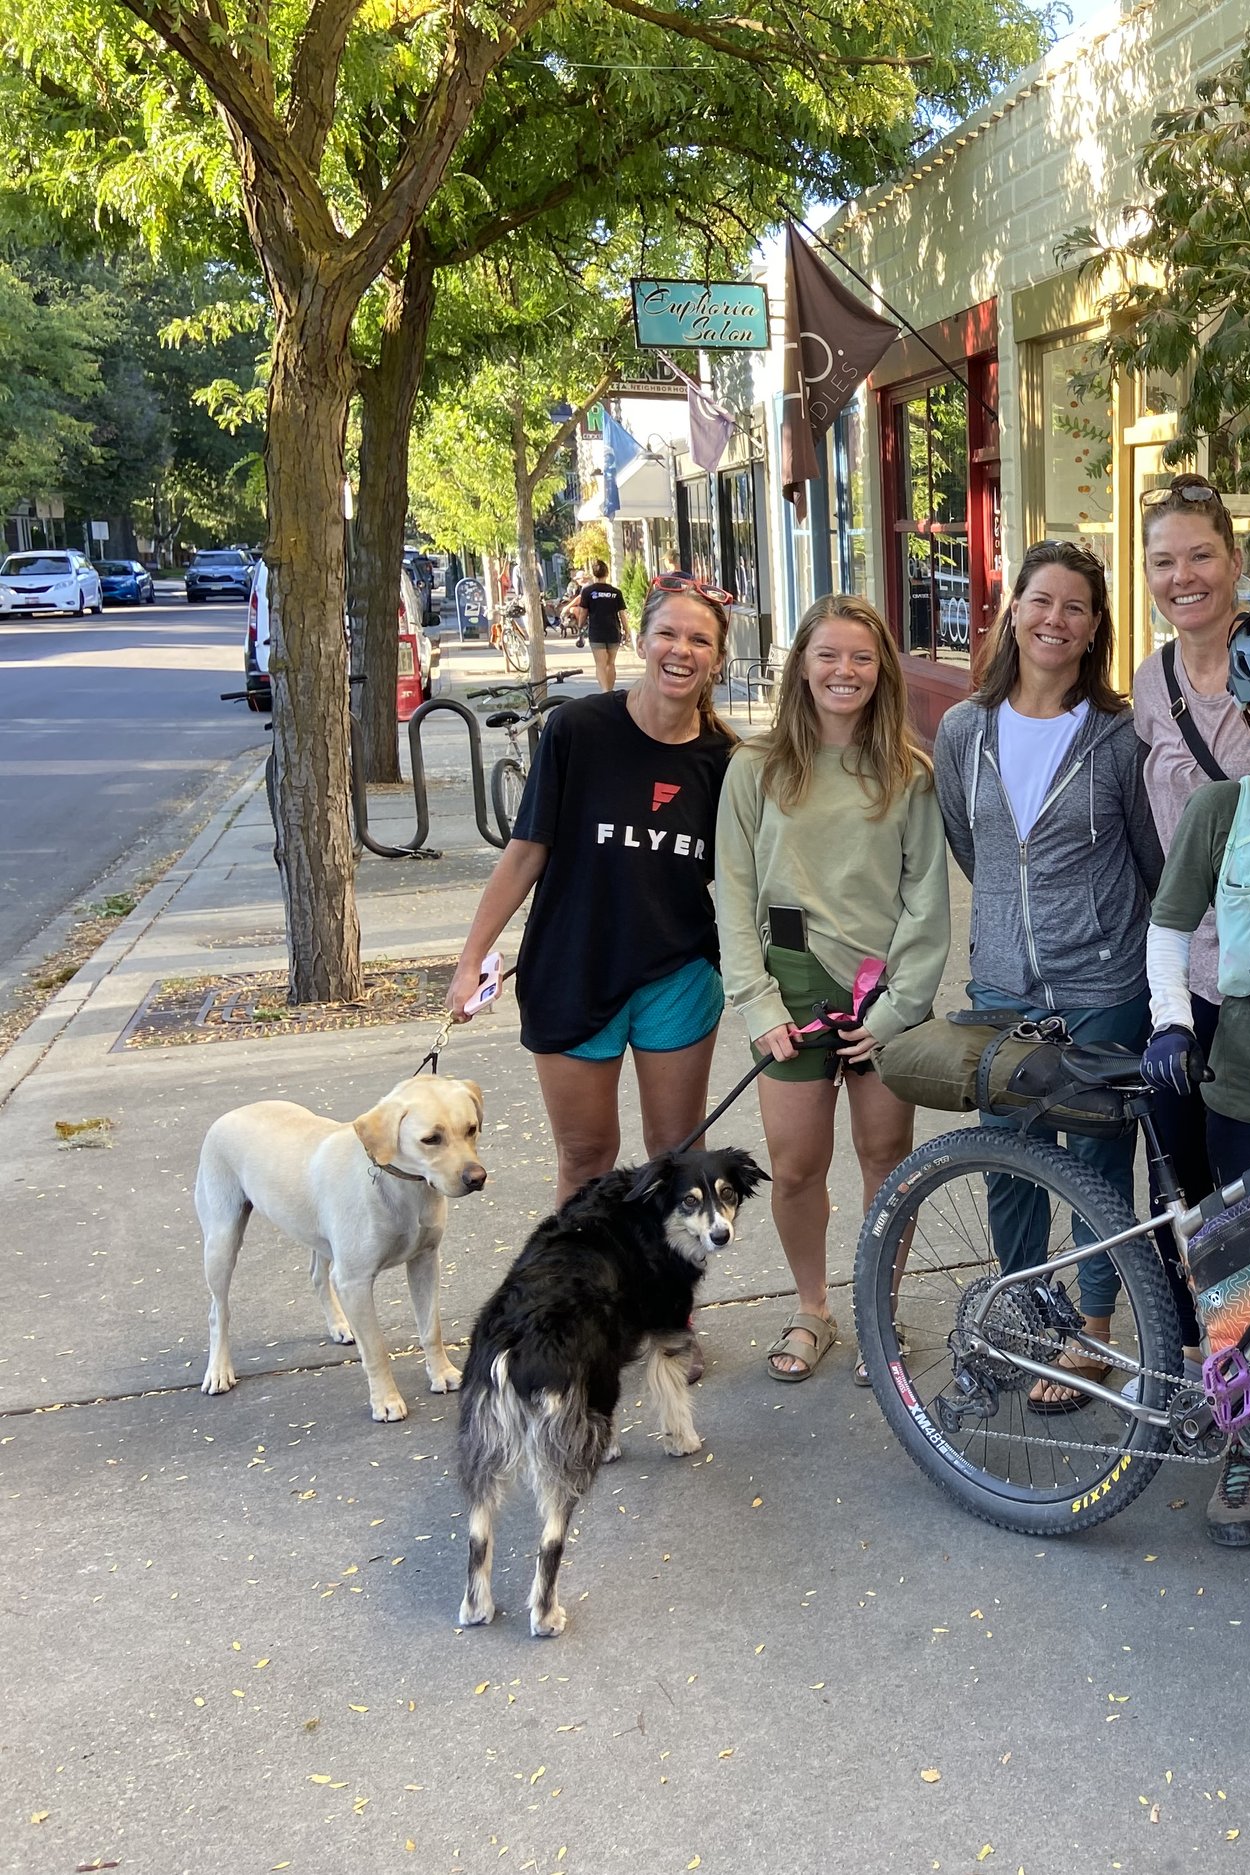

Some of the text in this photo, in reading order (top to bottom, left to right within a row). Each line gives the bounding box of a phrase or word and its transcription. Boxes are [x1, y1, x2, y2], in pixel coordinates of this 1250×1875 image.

[643, 287, 759, 325] Euphoria
[683, 315, 755, 343] Salon
[630, 384, 689, 394] NEIGHBORHOO
[597, 823, 706, 860] FLYER
[1071, 1455, 1132, 1513] MAXXIS
